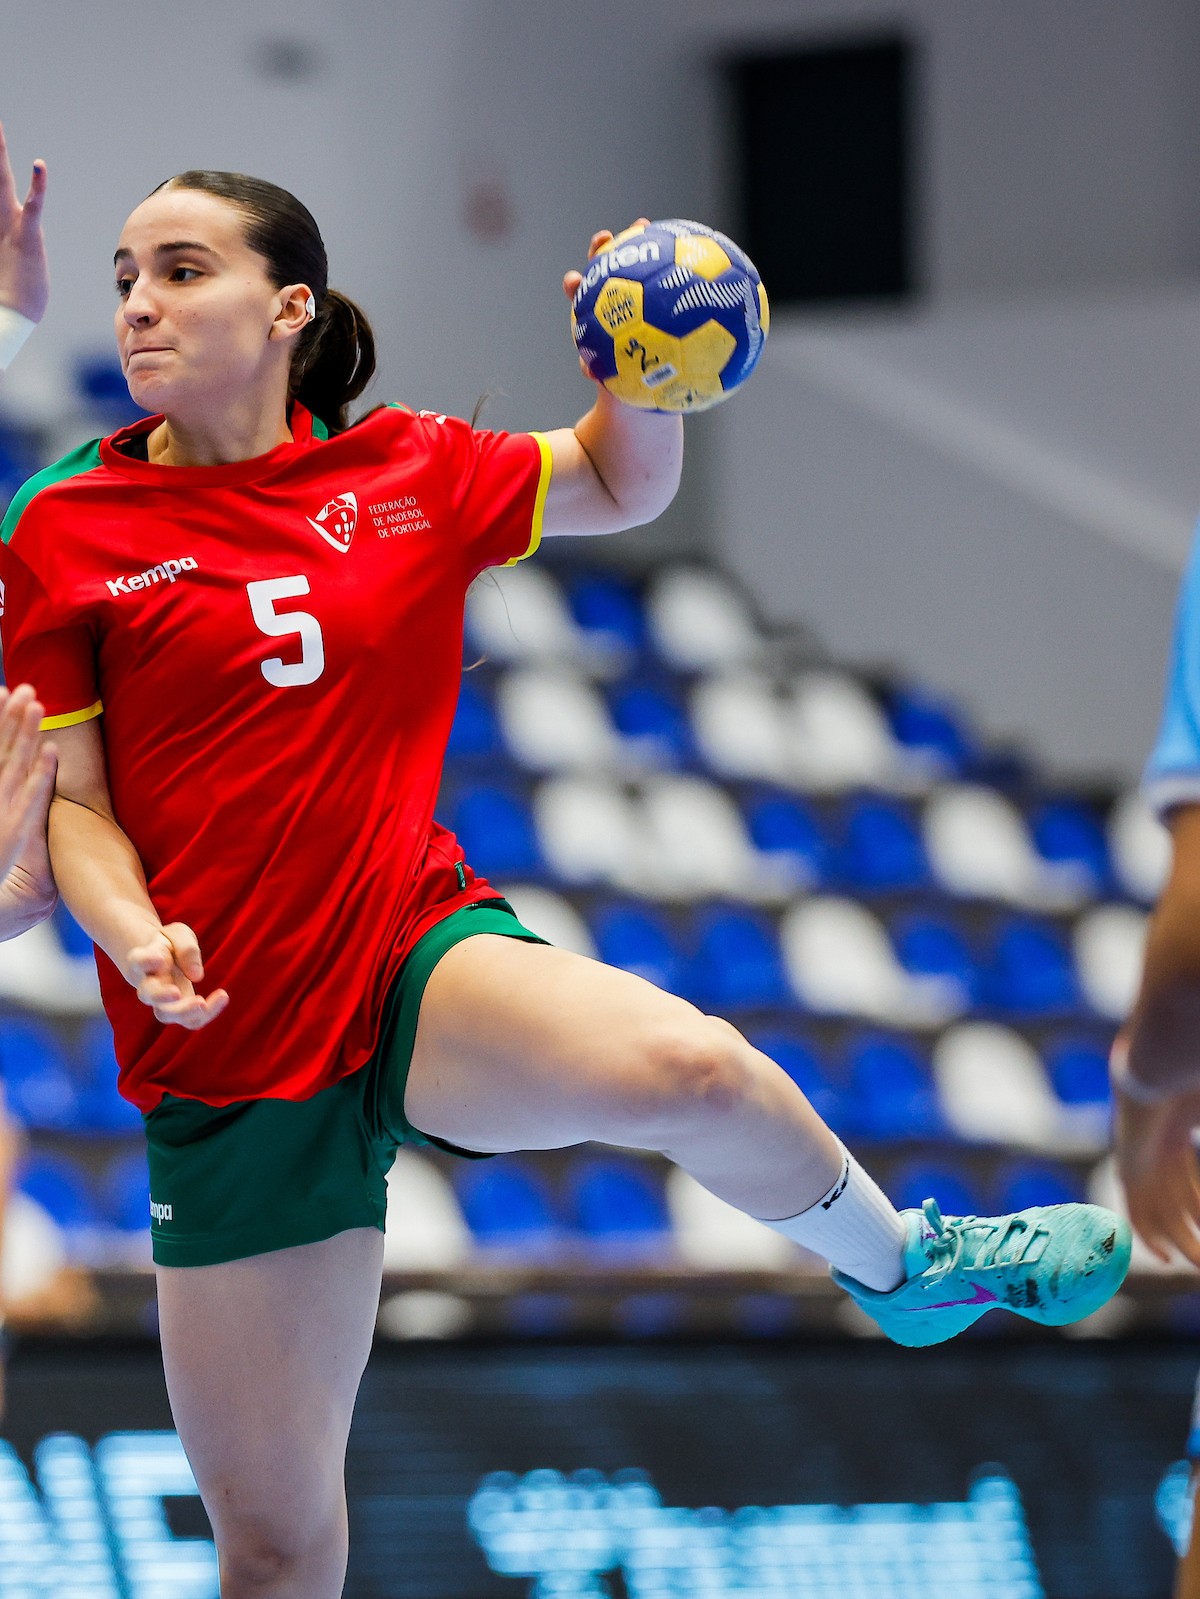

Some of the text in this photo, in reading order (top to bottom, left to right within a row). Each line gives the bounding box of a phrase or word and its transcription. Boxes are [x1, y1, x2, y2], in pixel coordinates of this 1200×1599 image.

[368, 496, 417, 515] FEDERAÇÃO
[373, 508, 425, 527] DE ANDEBOL
[377, 519, 432, 539] DE PORTUGAL
[105, 556, 199, 597] Kempa
[246, 574, 325, 688] 5
